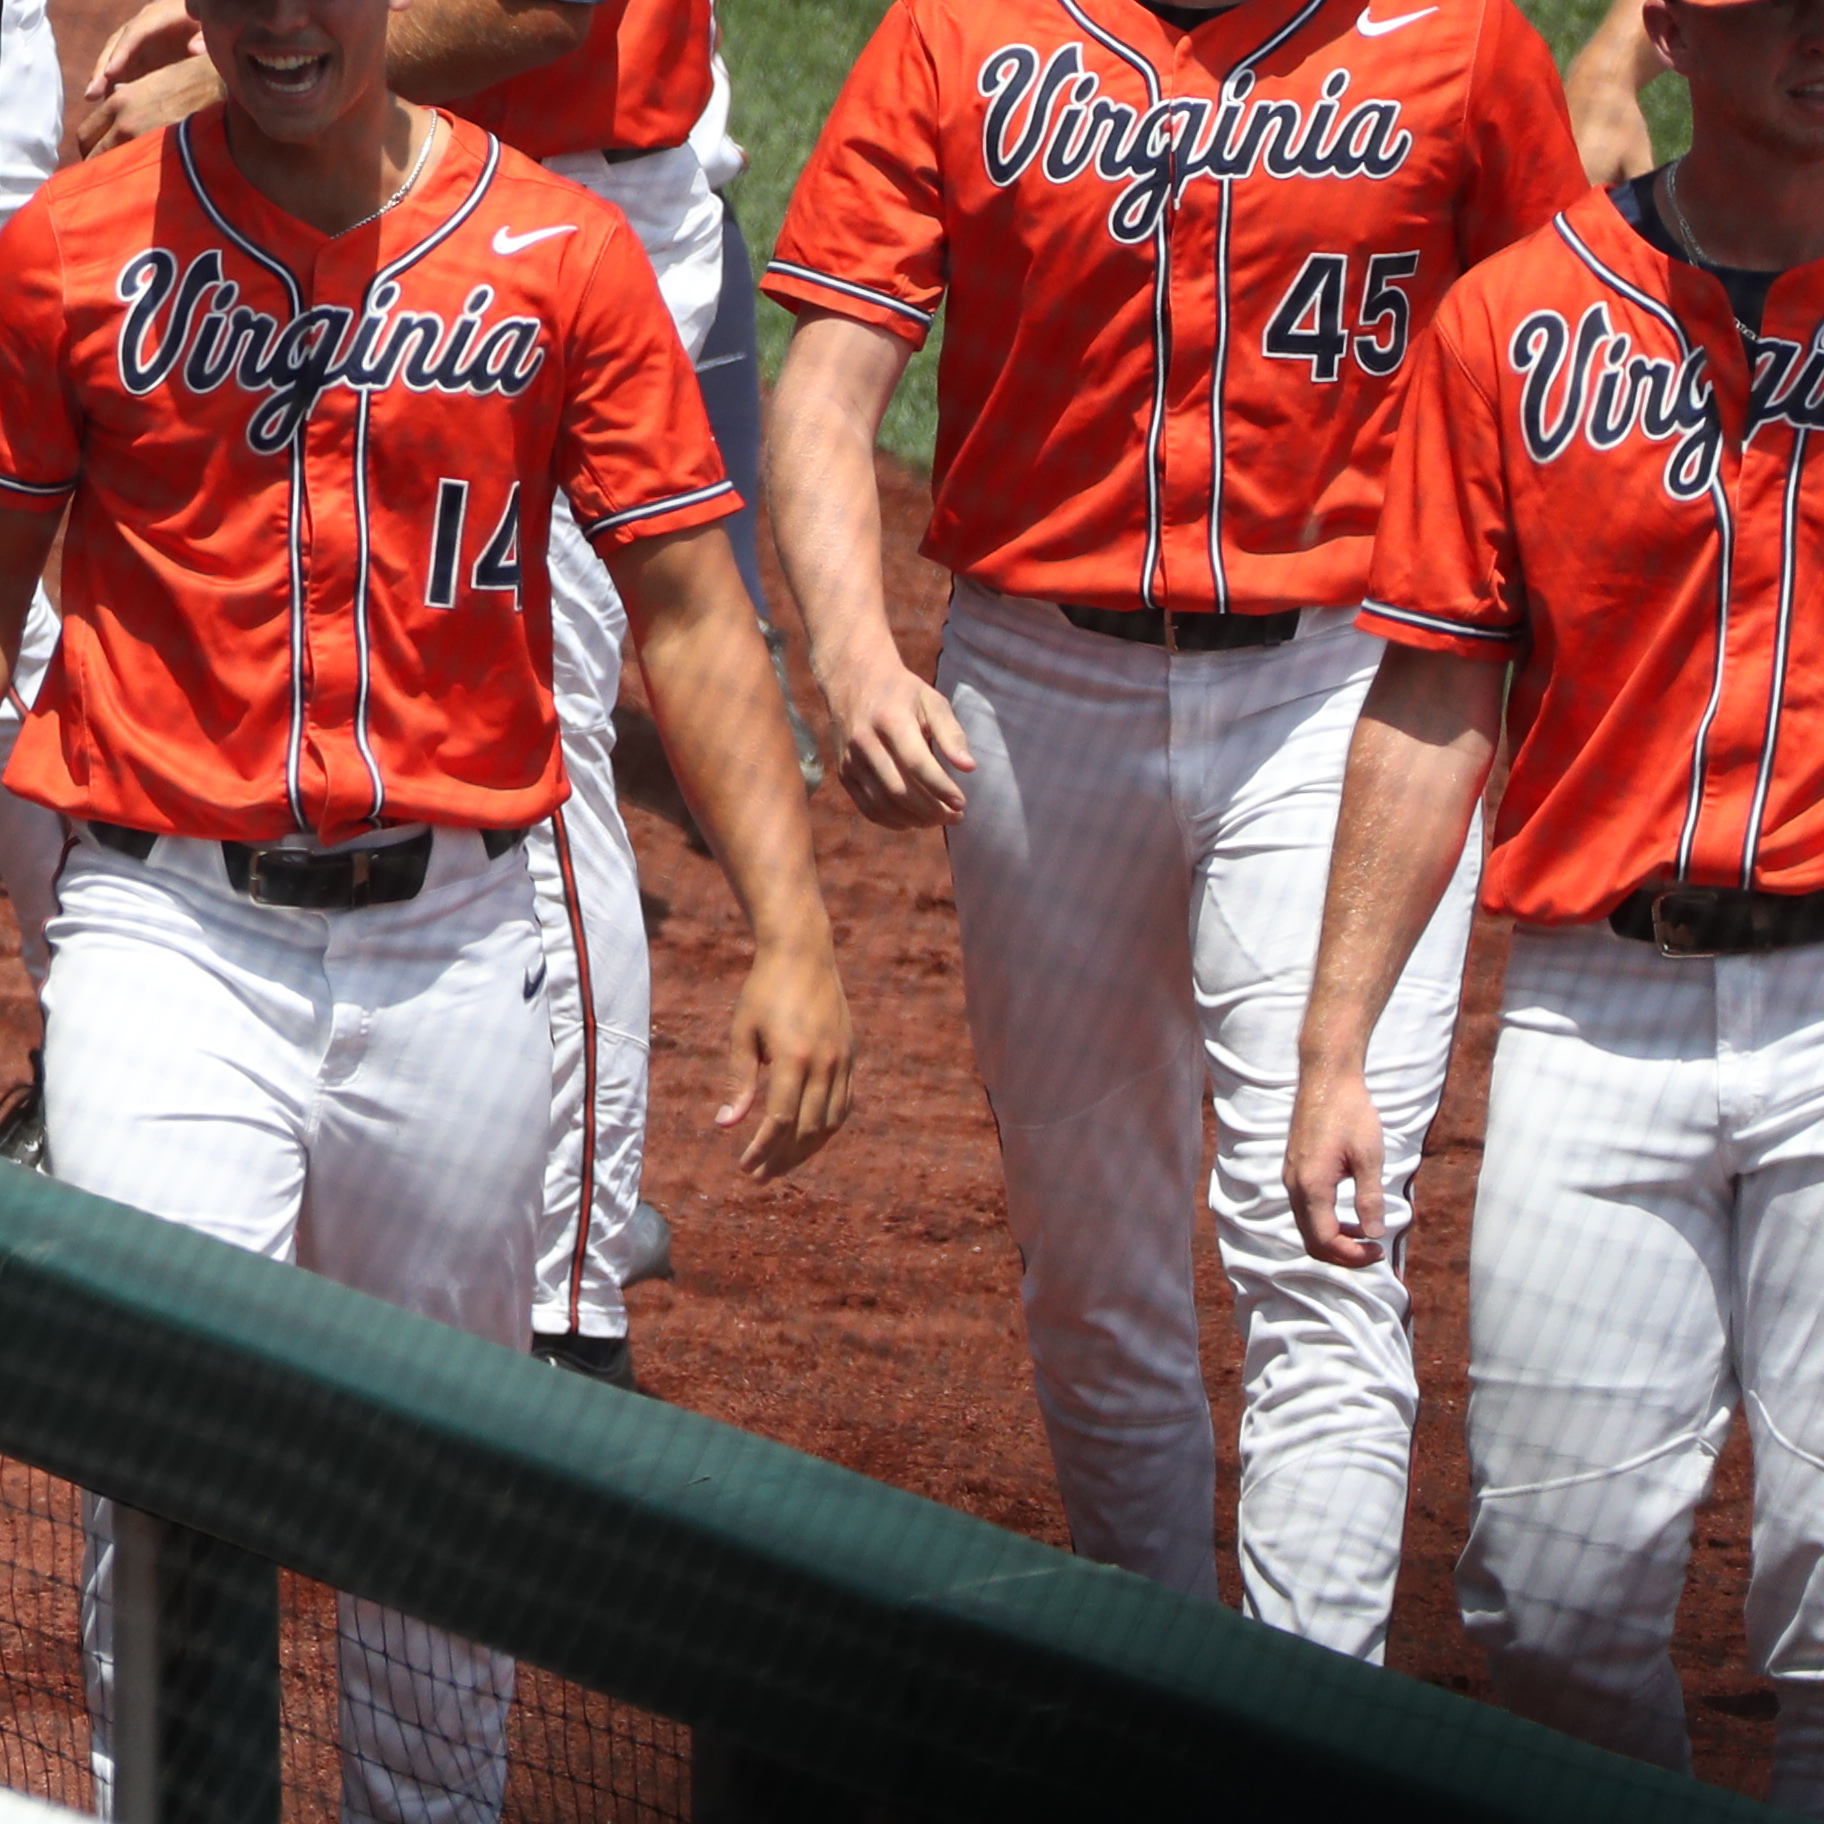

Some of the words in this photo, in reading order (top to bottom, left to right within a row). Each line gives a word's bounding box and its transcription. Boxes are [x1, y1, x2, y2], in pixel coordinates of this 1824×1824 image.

[979, 42, 1412, 243] Virginia
[115, 247, 544, 454] Virginia
[1261, 249, 1419, 383] 45
[424, 478, 524, 610] 14
